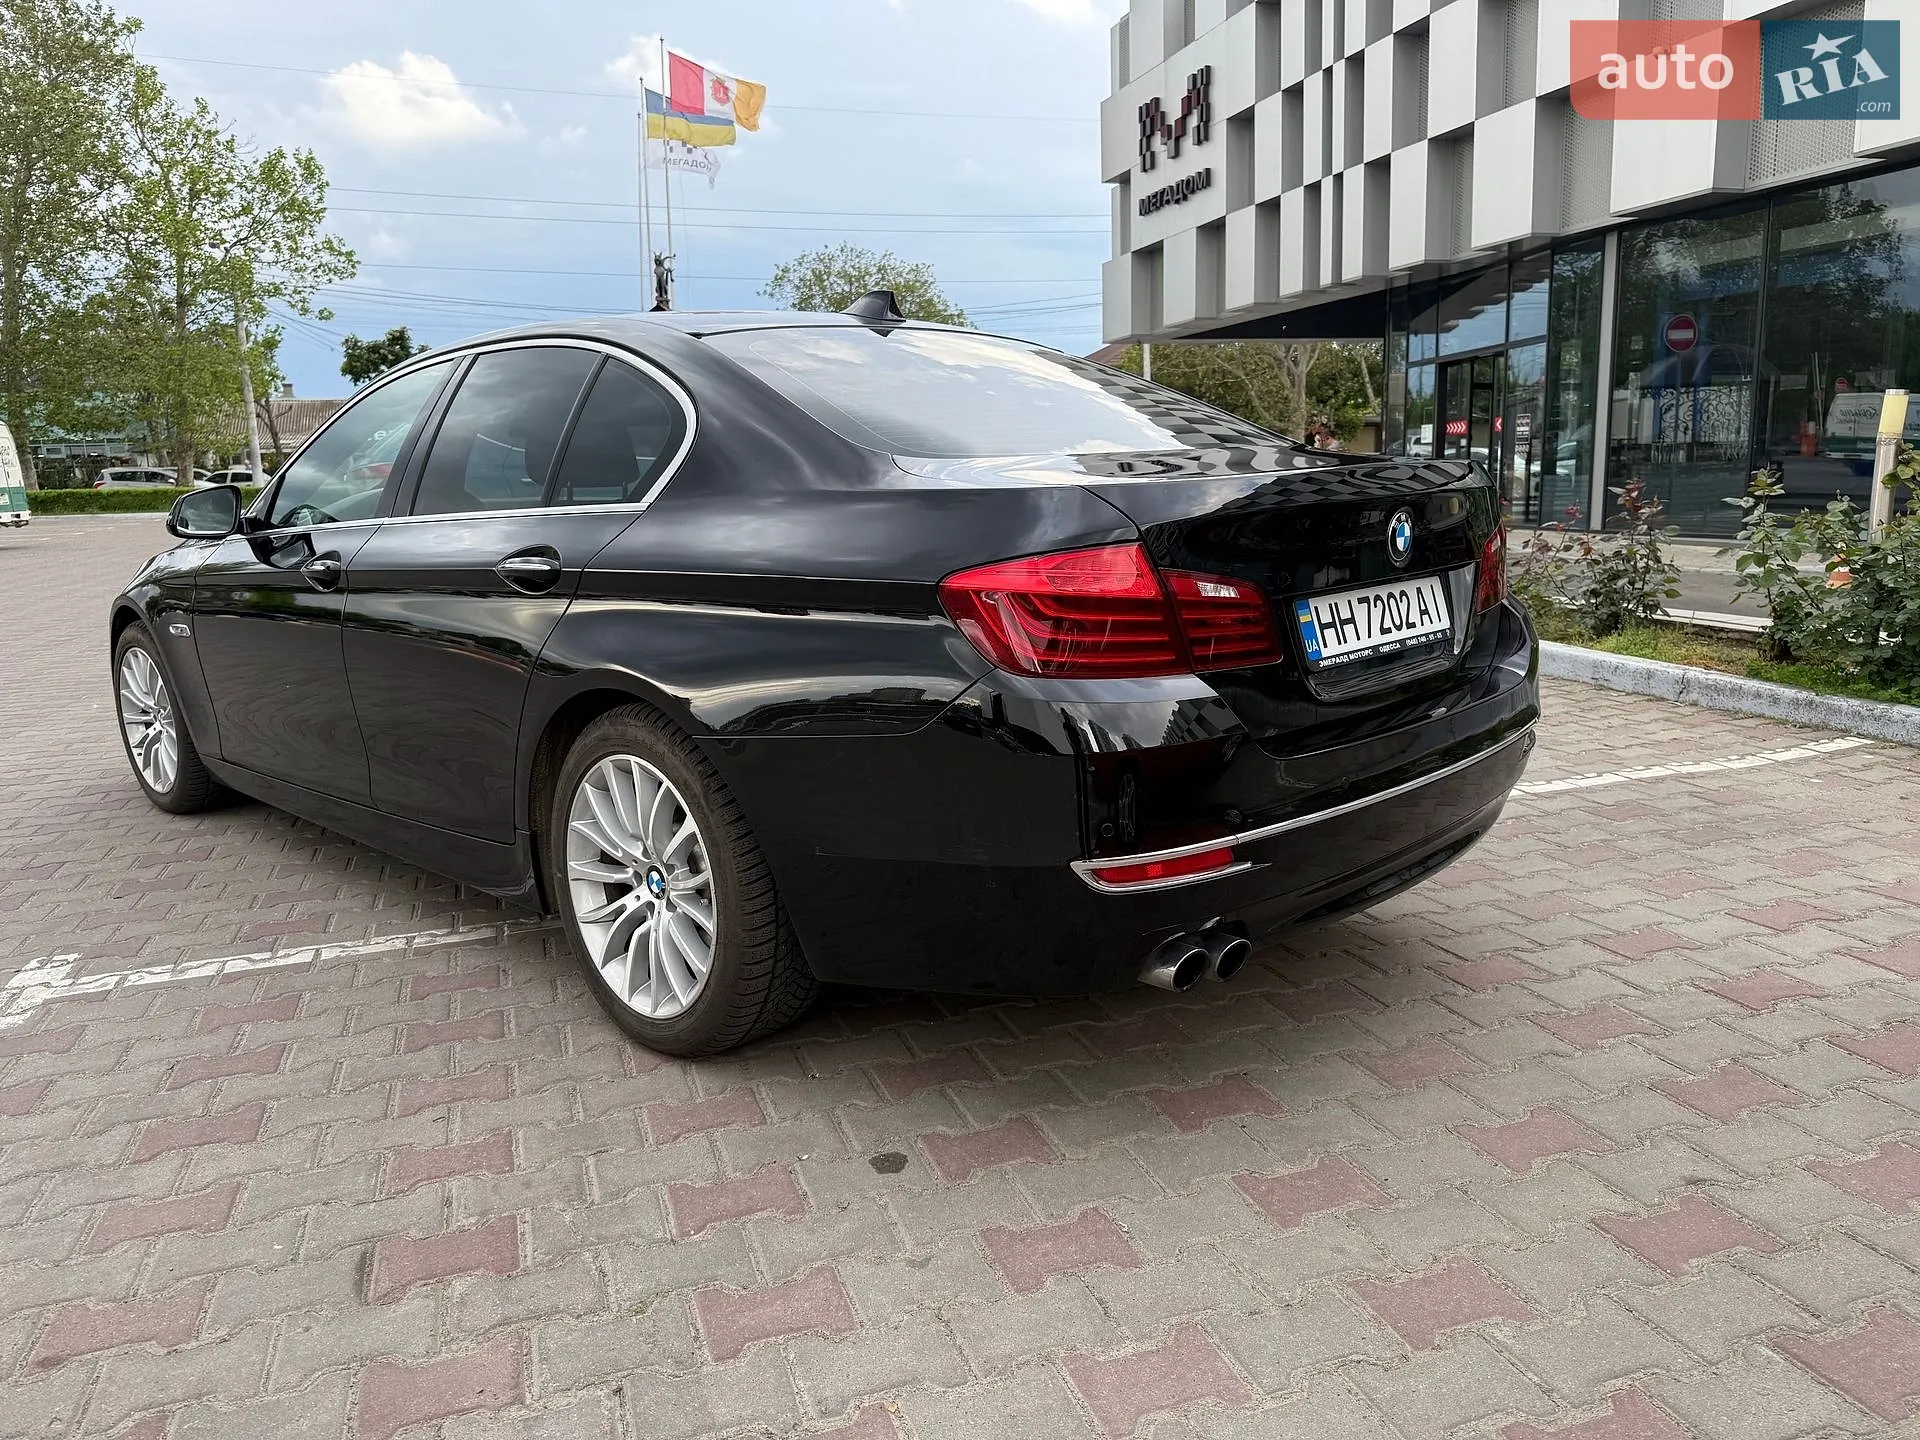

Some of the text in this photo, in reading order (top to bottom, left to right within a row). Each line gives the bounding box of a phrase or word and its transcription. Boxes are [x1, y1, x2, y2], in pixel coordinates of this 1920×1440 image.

[1139, 168, 1211, 216] МЕГАДОМ
[1306, 639, 1319, 652] UA
[1319, 655, 1349, 668] ЭМЕРАЛД
[1349, 650, 1373, 661] МОТОРС
[1379, 642, 1400, 652] ОДЕССА
